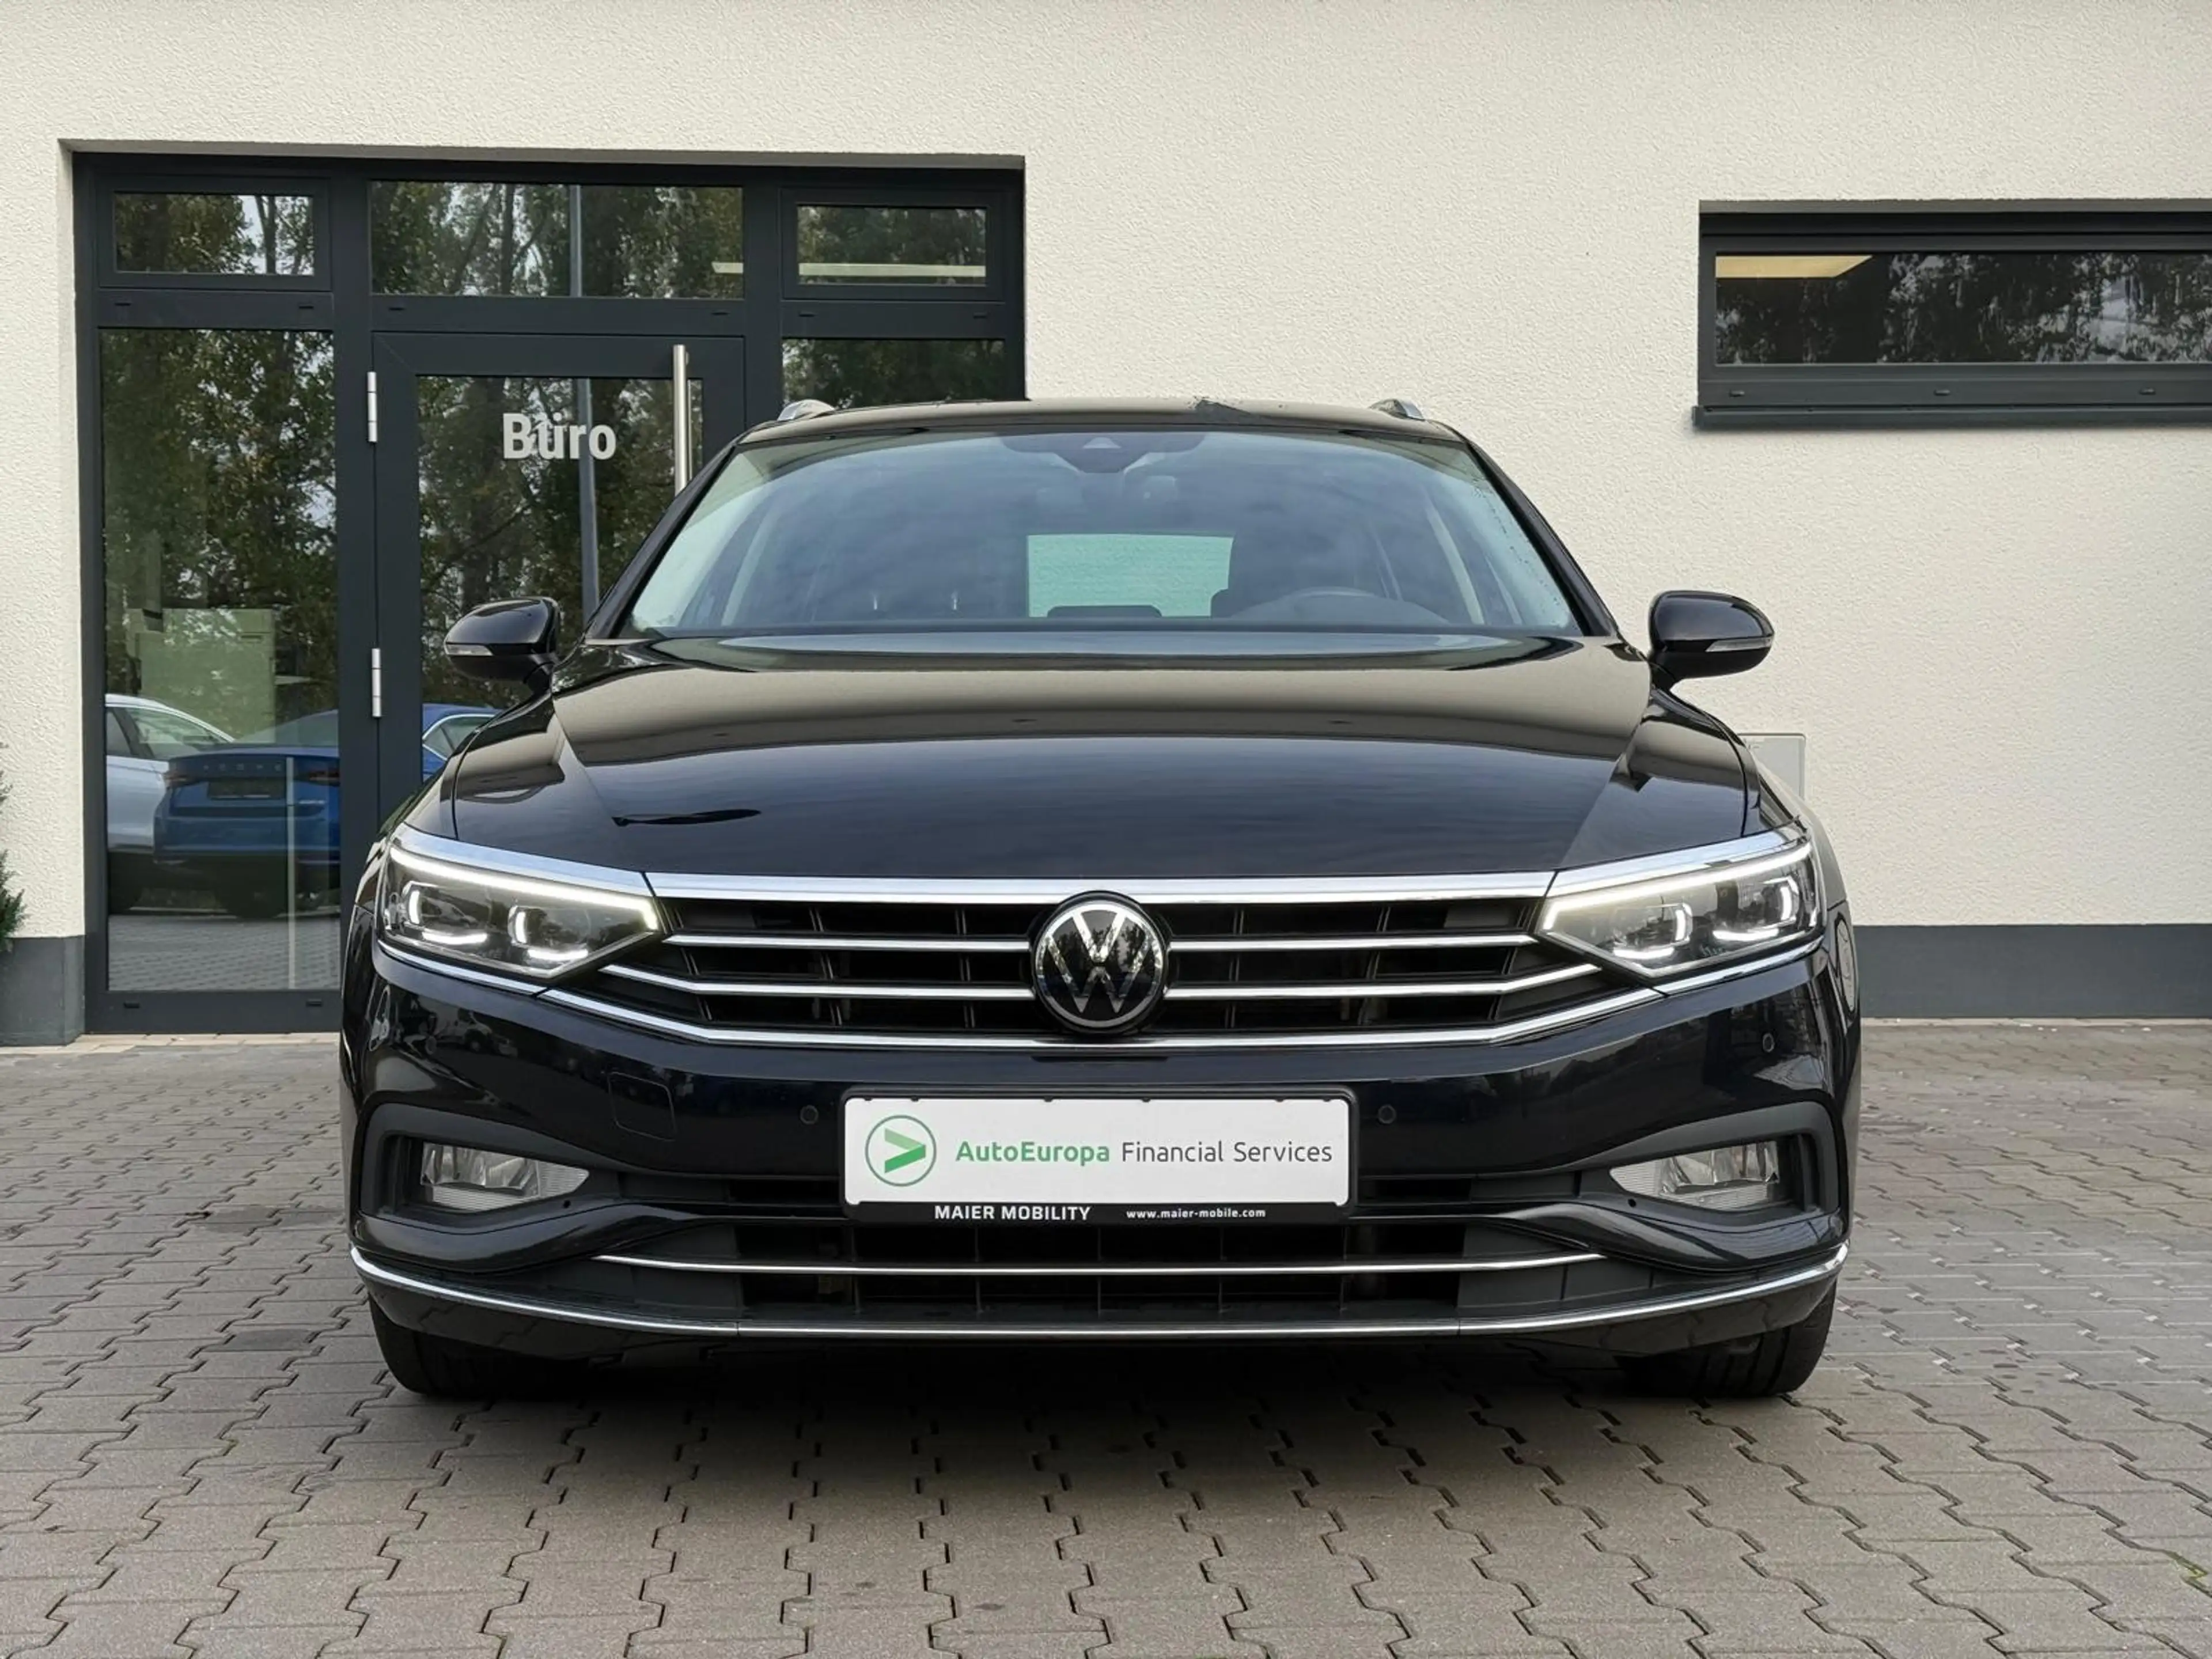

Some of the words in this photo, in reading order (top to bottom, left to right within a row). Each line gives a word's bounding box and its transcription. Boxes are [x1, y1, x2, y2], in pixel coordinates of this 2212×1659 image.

[503, 411, 616, 460] Büro
[955, 1141, 1110, 1166] AutoEuropa
[1122, 1140, 1224, 1162] Financial
[1233, 1141, 1332, 1162] Services
[934, 1205, 995, 1220] MAIER
[1001, 1206, 1090, 1221] MOBILITY
[1126, 1208, 1267, 1219] www.maier-mobile.com
